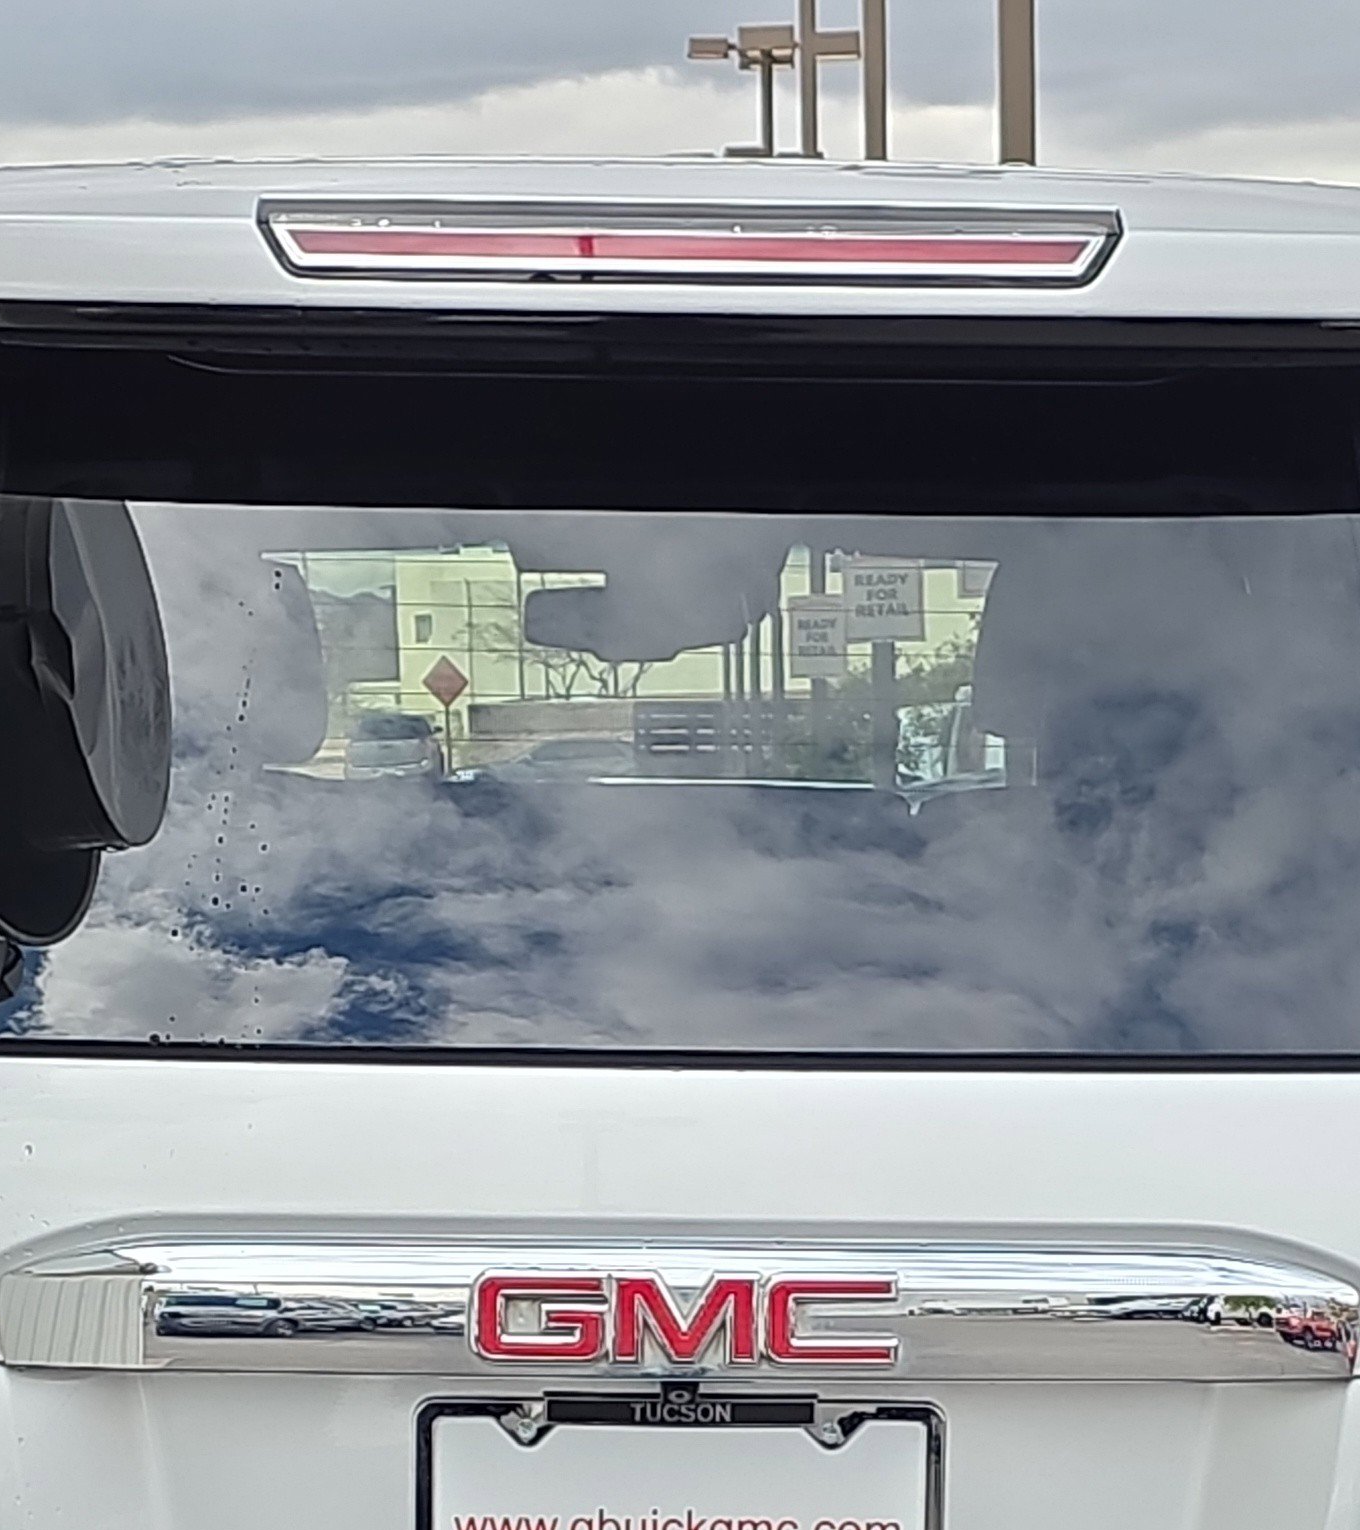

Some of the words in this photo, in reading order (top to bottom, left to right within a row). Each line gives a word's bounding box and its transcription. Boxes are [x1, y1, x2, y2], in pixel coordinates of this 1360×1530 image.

[854, 573, 909, 586] READY
[866, 589, 898, 601] FOR
[470, 1270, 899, 1366] GMC
[630, 1402, 733, 1424] TUCSON
